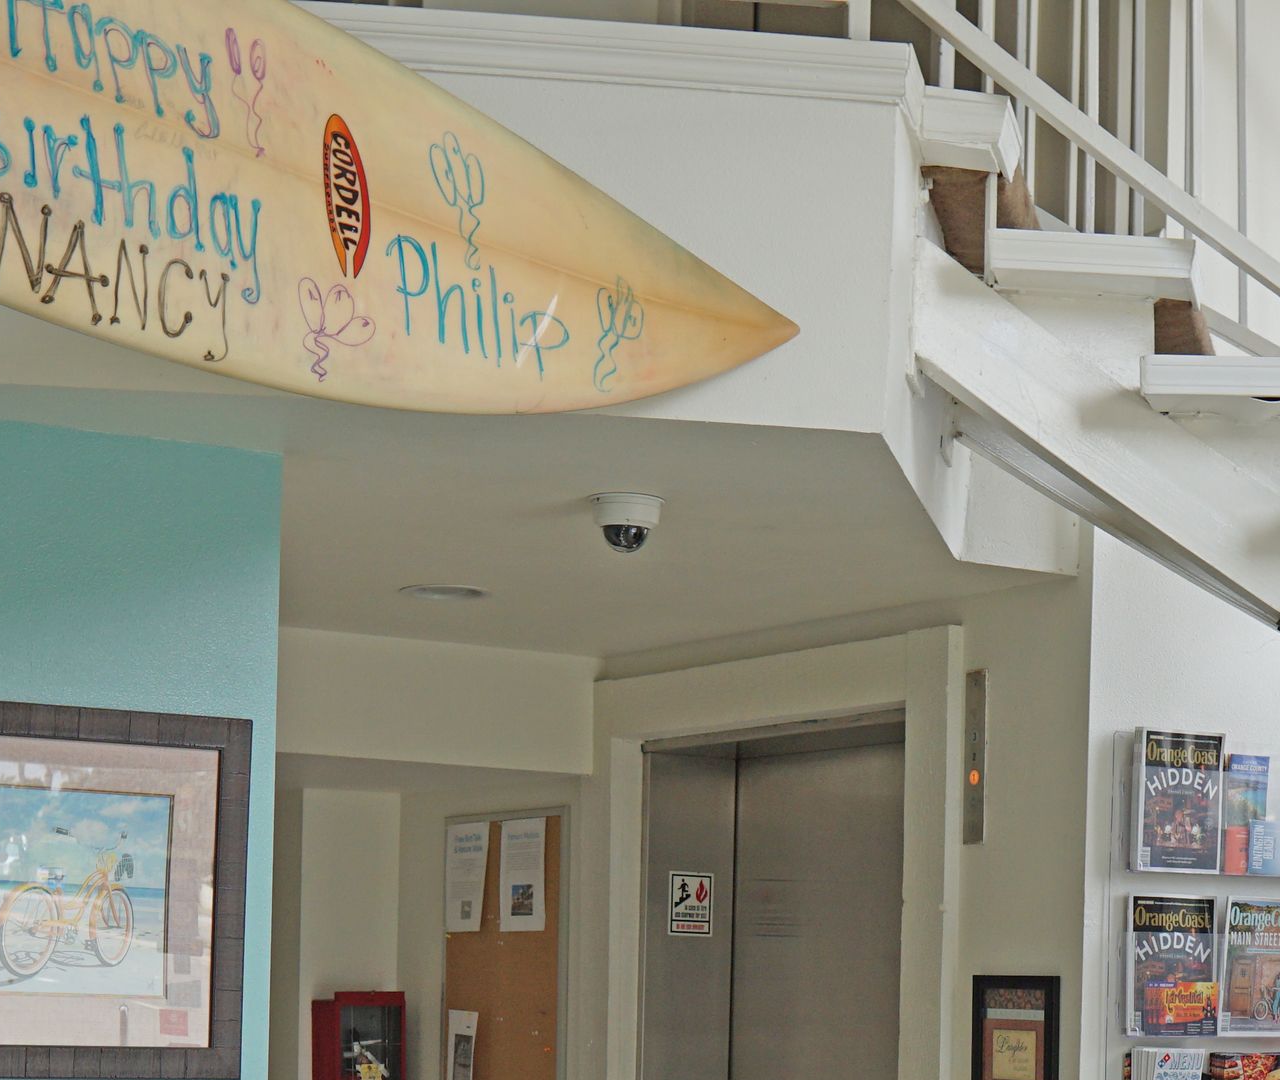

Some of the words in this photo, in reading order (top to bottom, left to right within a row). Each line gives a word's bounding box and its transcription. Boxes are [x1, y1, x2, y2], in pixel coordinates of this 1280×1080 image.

[7, 0, 220, 138] Happy
[331, 131, 358, 251] CORDELL
[387, 233, 570, 380] Philip
[1147, 768, 1217, 800] HIDDEN
[1136, 932, 1211, 963] HIDDEN
[1230, 932, 1251, 945] MAIN
